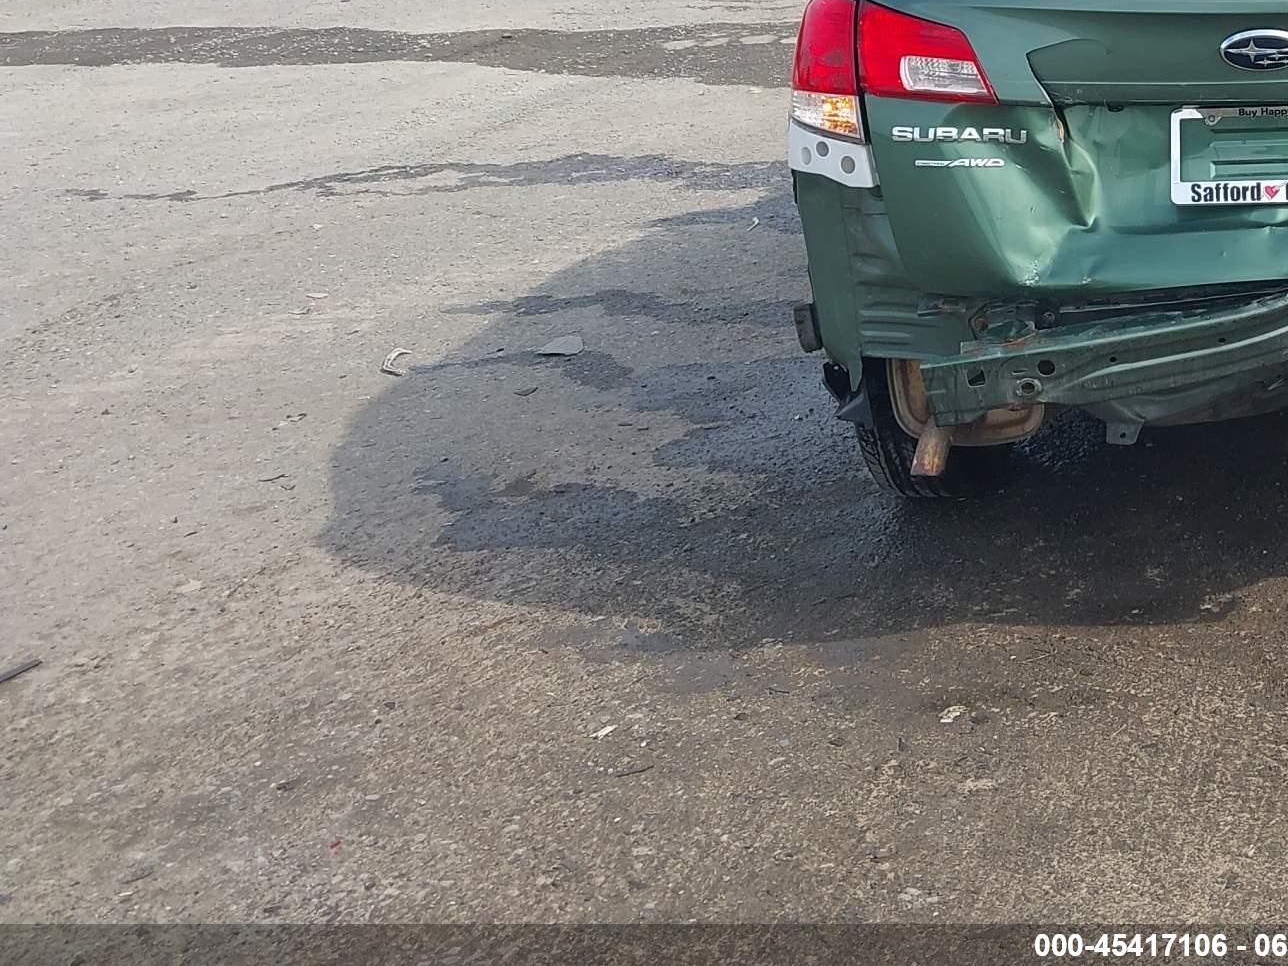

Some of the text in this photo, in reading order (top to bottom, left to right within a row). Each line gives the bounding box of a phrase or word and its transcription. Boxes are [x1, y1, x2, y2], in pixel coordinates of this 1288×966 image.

[1238, 108, 1258, 118] Buy
[891, 126, 1028, 145] SUBARU
[948, 158, 1005, 167] AWD
[1191, 182, 1262, 202] Safford
